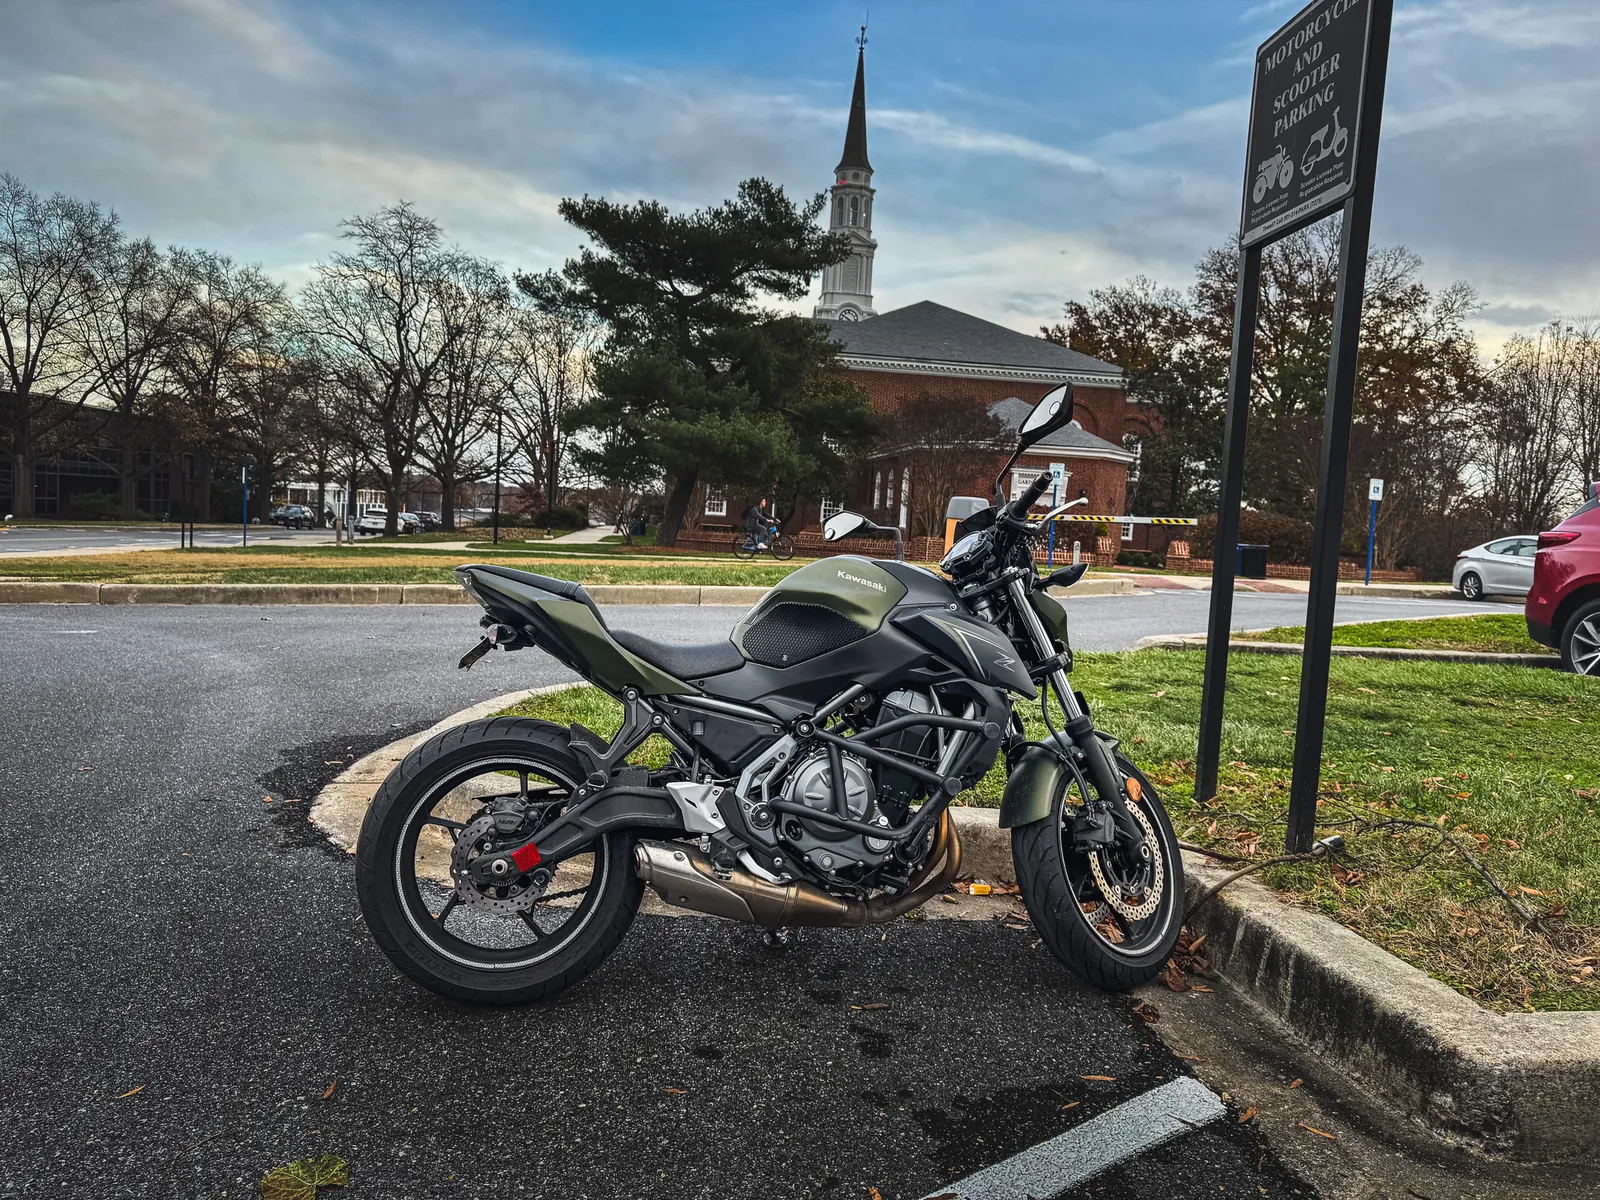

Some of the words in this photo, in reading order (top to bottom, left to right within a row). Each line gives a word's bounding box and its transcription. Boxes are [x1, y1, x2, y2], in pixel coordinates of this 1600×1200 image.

[1292, 41, 1323, 77] AND
[1272, 53, 1341, 115] SCOOTER
[1273, 82, 1336, 138] PARKING
[1299, 181, 1324, 198] Registration
[1323, 169, 1344, 185] Required
[1300, 177, 1316, 190] Scooter
[1271, 200, 1288, 212] Required
[837, 569, 887, 593] Kawasaki
